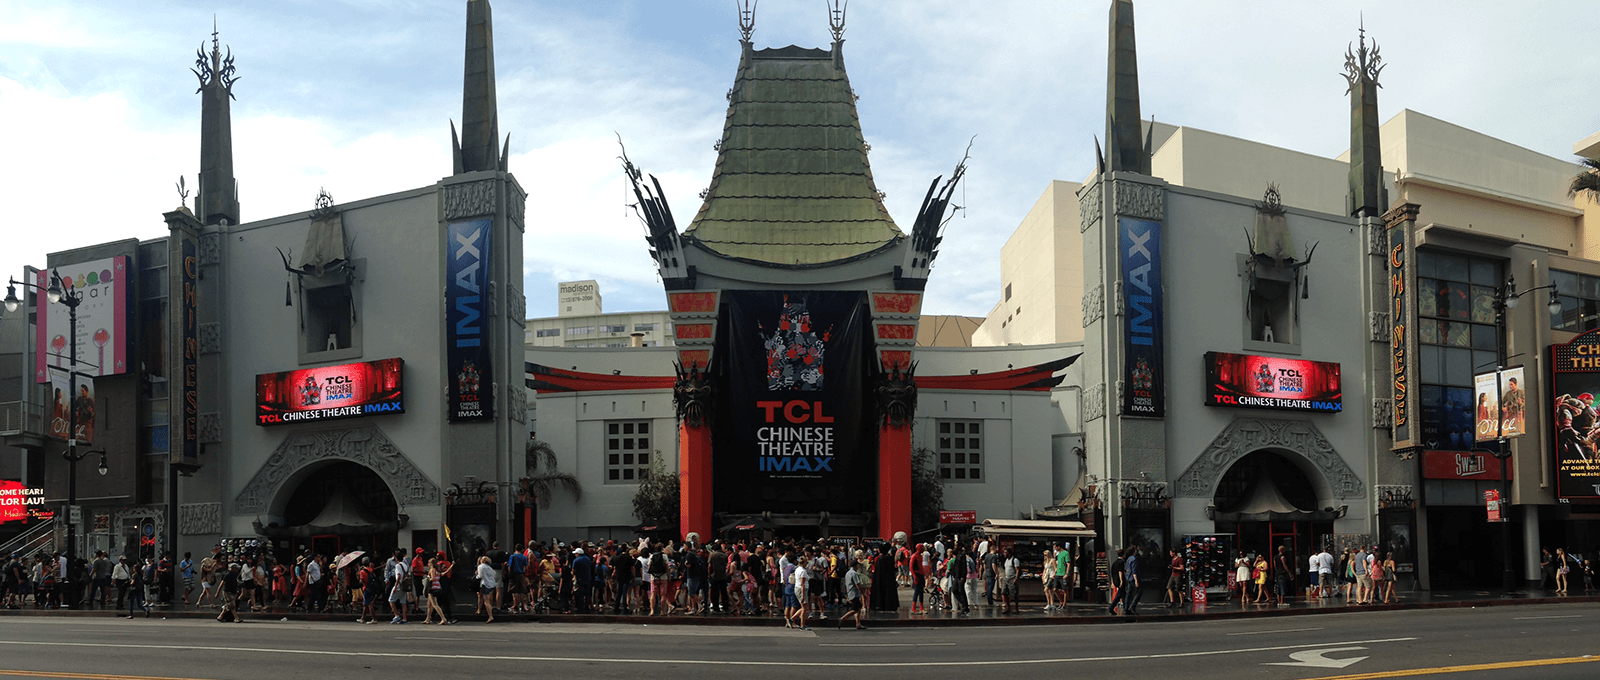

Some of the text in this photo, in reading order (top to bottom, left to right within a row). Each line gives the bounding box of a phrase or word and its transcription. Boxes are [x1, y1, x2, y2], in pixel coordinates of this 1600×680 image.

[456, 227, 480, 348] IMAX
[561, 284, 593, 293] madison
[1128, 229, 1153, 346] IMAX
[1391, 244, 1406, 426] CHINESE
[185, 256, 197, 440] CHINESE
[325, 376, 353, 384] TCL
[1278, 368, 1303, 377] TCL
[460, 394, 480, 402] TCL
[1134, 389, 1152, 397] TCL
[1214, 394, 1342, 411] TCL CHINESE THEATRE IMAX
[260, 401, 401, 424] TCL CHINESE THEATRE IMAX
[457, 409, 483, 417] IMAX
[756, 399, 835, 424] TCL
[756, 427, 834, 441] CHINESE
[757, 441, 834, 456] THEATRE
[759, 456, 833, 472] IMAX
[1455, 453, 1485, 476] SWT!
[1194, 590, 1206, 600] $5
